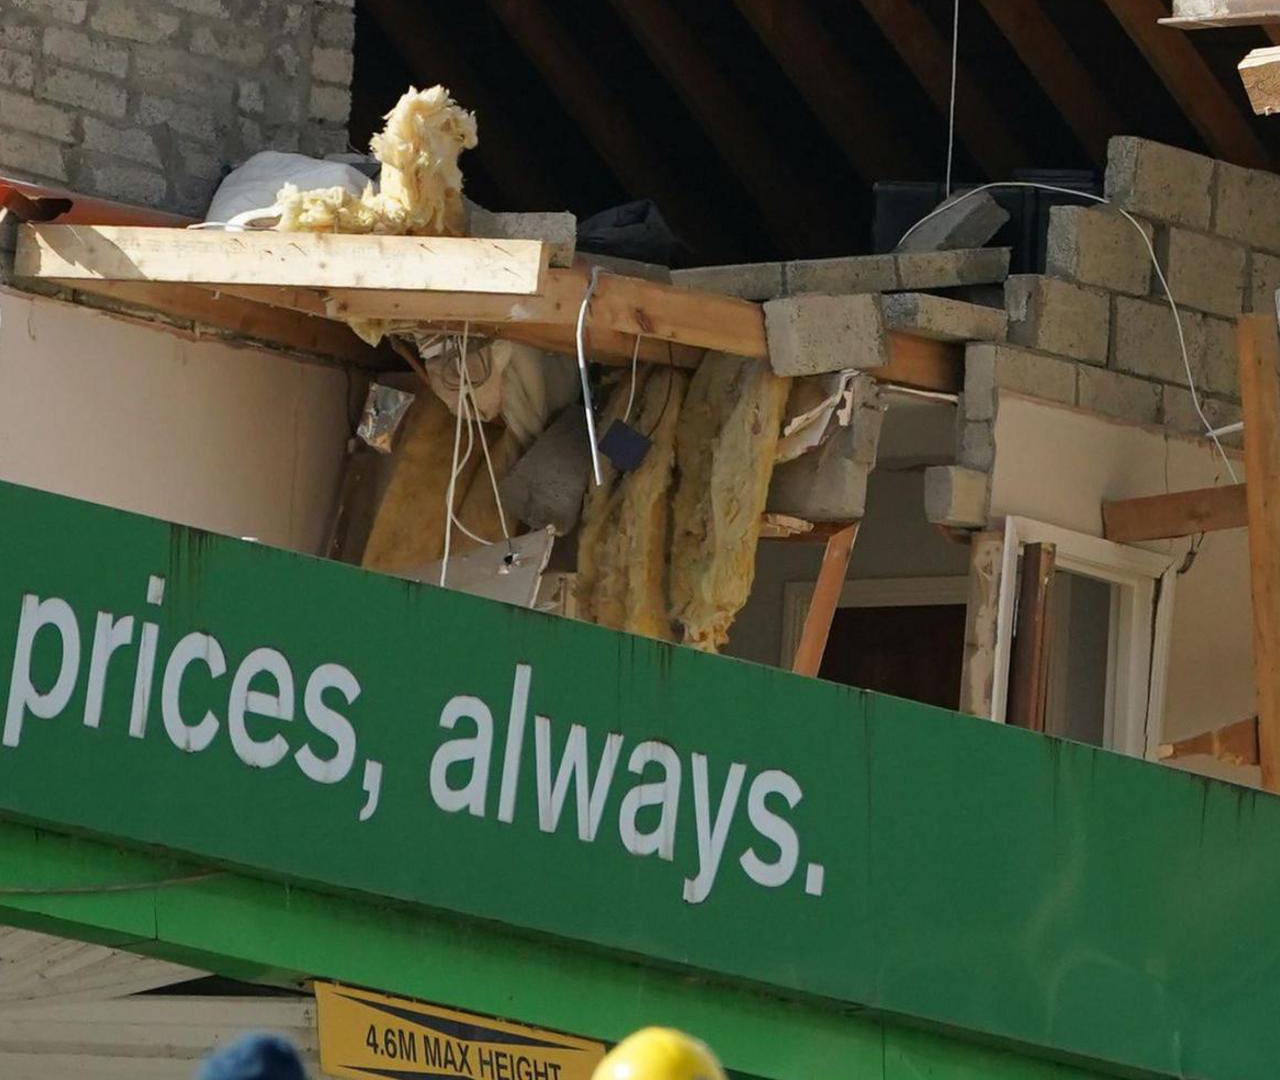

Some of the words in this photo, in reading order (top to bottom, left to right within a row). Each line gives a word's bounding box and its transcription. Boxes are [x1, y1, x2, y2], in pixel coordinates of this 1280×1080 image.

[2, 575, 383, 821] prices,
[430, 664, 824, 903] always.
[365, 1024, 417, 1063] 4.6M
[423, 1034, 473, 1077] MAX
[478, 1046, 562, 1080] HEIGHT
